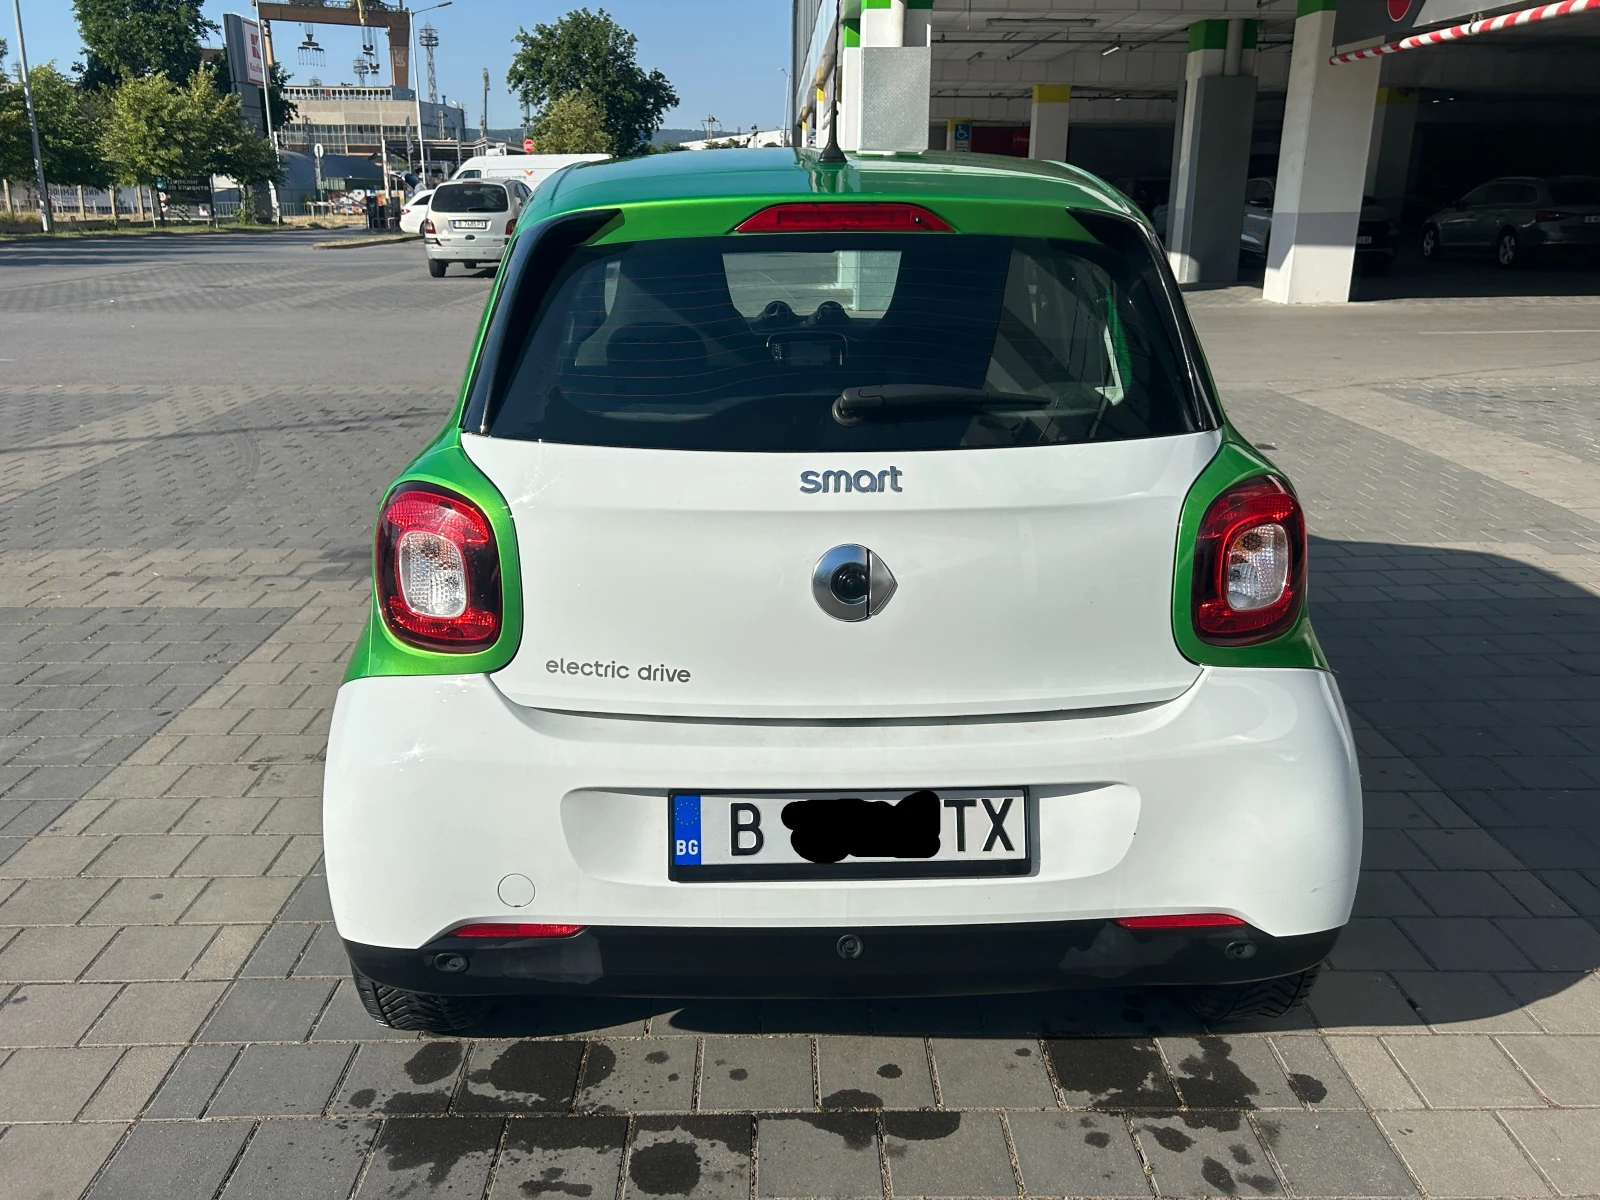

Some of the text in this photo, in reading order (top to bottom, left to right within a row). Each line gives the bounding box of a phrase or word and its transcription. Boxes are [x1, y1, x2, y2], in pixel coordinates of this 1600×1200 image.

[800, 465, 903, 494] smart
[545, 657, 691, 683] electric drive
[730, 799, 1014, 856] B TX
[676, 839, 699, 856] BG
